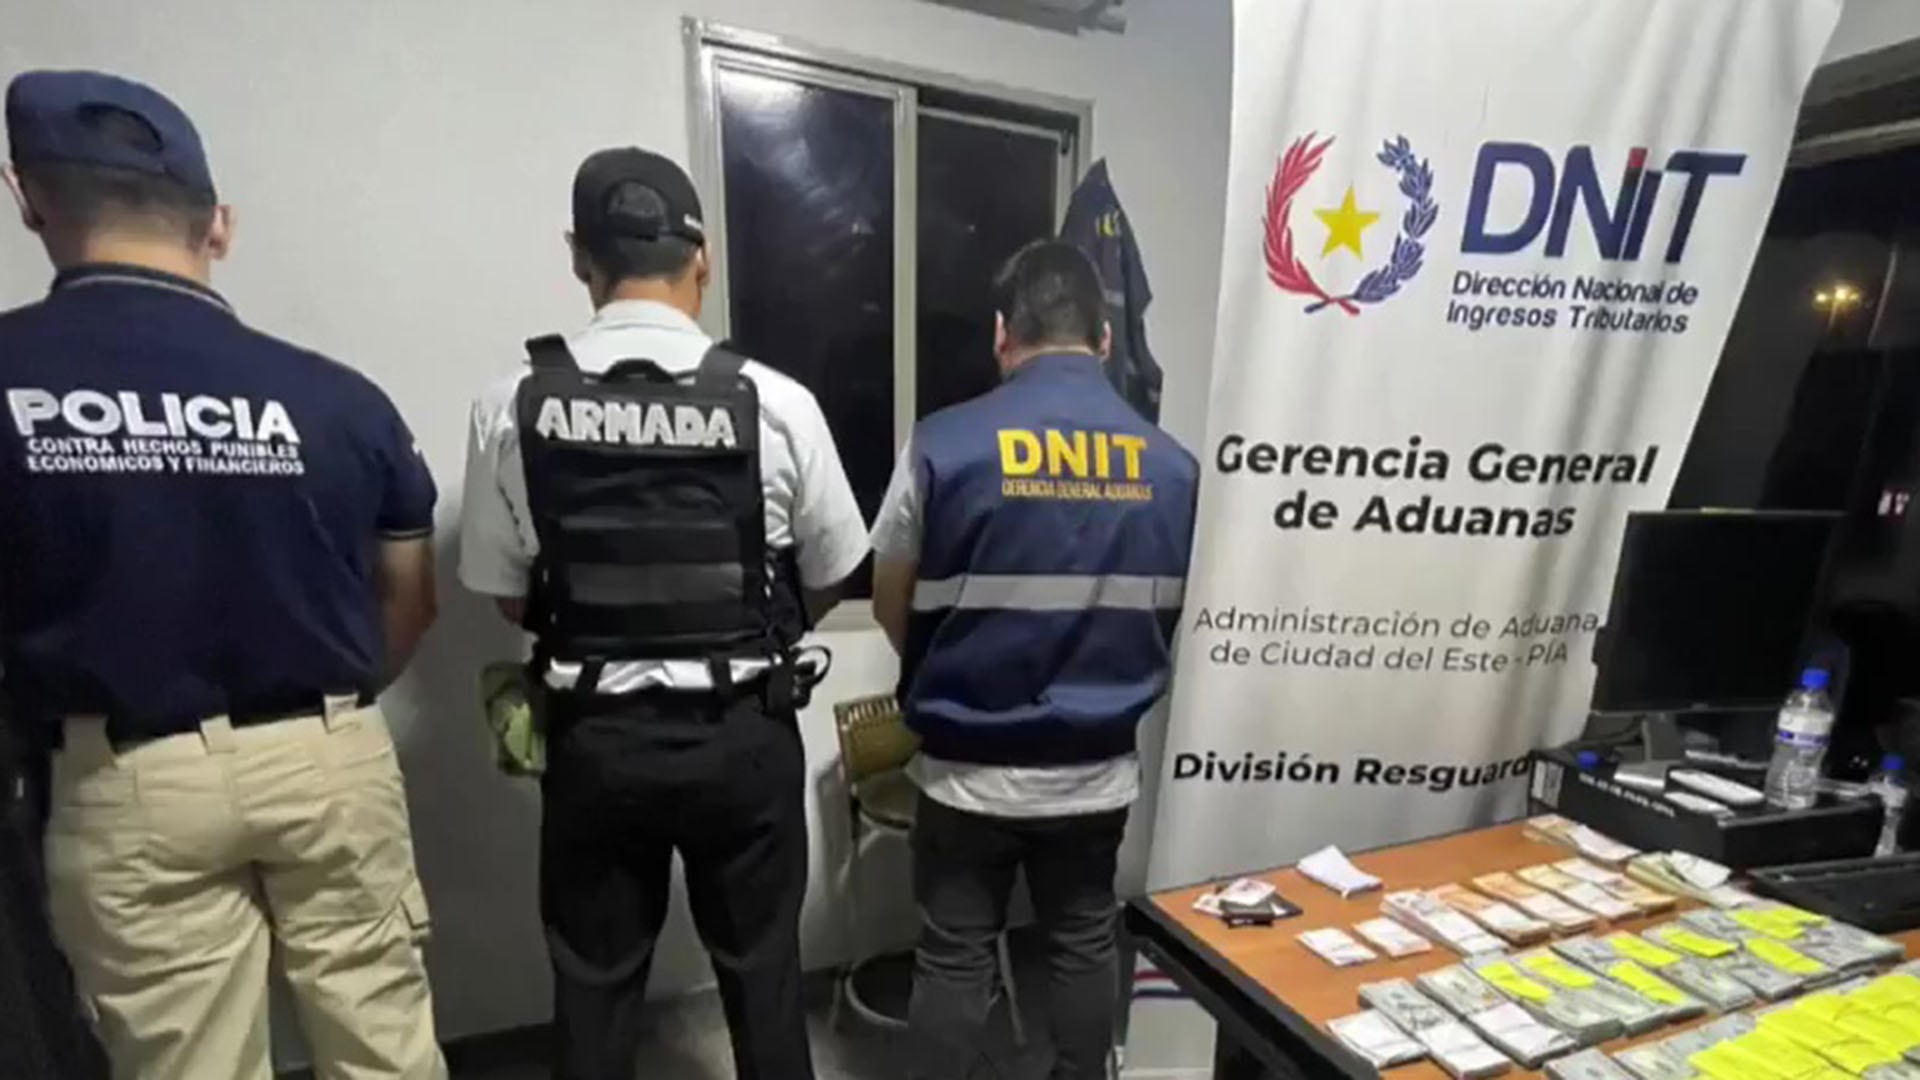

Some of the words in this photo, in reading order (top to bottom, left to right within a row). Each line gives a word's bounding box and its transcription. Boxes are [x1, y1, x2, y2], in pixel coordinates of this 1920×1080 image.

[1452, 270, 1566, 299] Dirección
[1572, 276, 1665, 304] Nacional
[1666, 281, 1698, 305] de
[1447, 300, 1557, 331] Ingresos
[1569, 305, 1689, 333] Tributarios
[5, 387, 301, 444] POLICIA
[535, 397, 737, 449] ARMADA
[27, 437, 115, 455] CONTRA
[121, 438, 202, 456] HECHOS
[210, 440, 299, 460] PUNIBLES
[27, 455, 164, 473] ECONOMICOS
[165, 456, 180, 473] Y
[185, 456, 305, 475] FINANCIEROS
[997, 429, 1148, 479] DNIT
[1216, 434, 1450, 481] Gerencia
[1468, 443, 1659, 485] General
[1273, 489, 1339, 531] de
[1353, 494, 1577, 538] Aduanas
[1193, 606, 1441, 639] Administración
[1450, 613, 1491, 640] de
[1210, 640, 1251, 666] de
[1260, 640, 1376, 670] Ciudad
[1384, 645, 1435, 671] del
[1443, 646, 1509, 674] Este
[1173, 751, 1341, 785] División
[1354, 750, 1533, 793] Resguard
